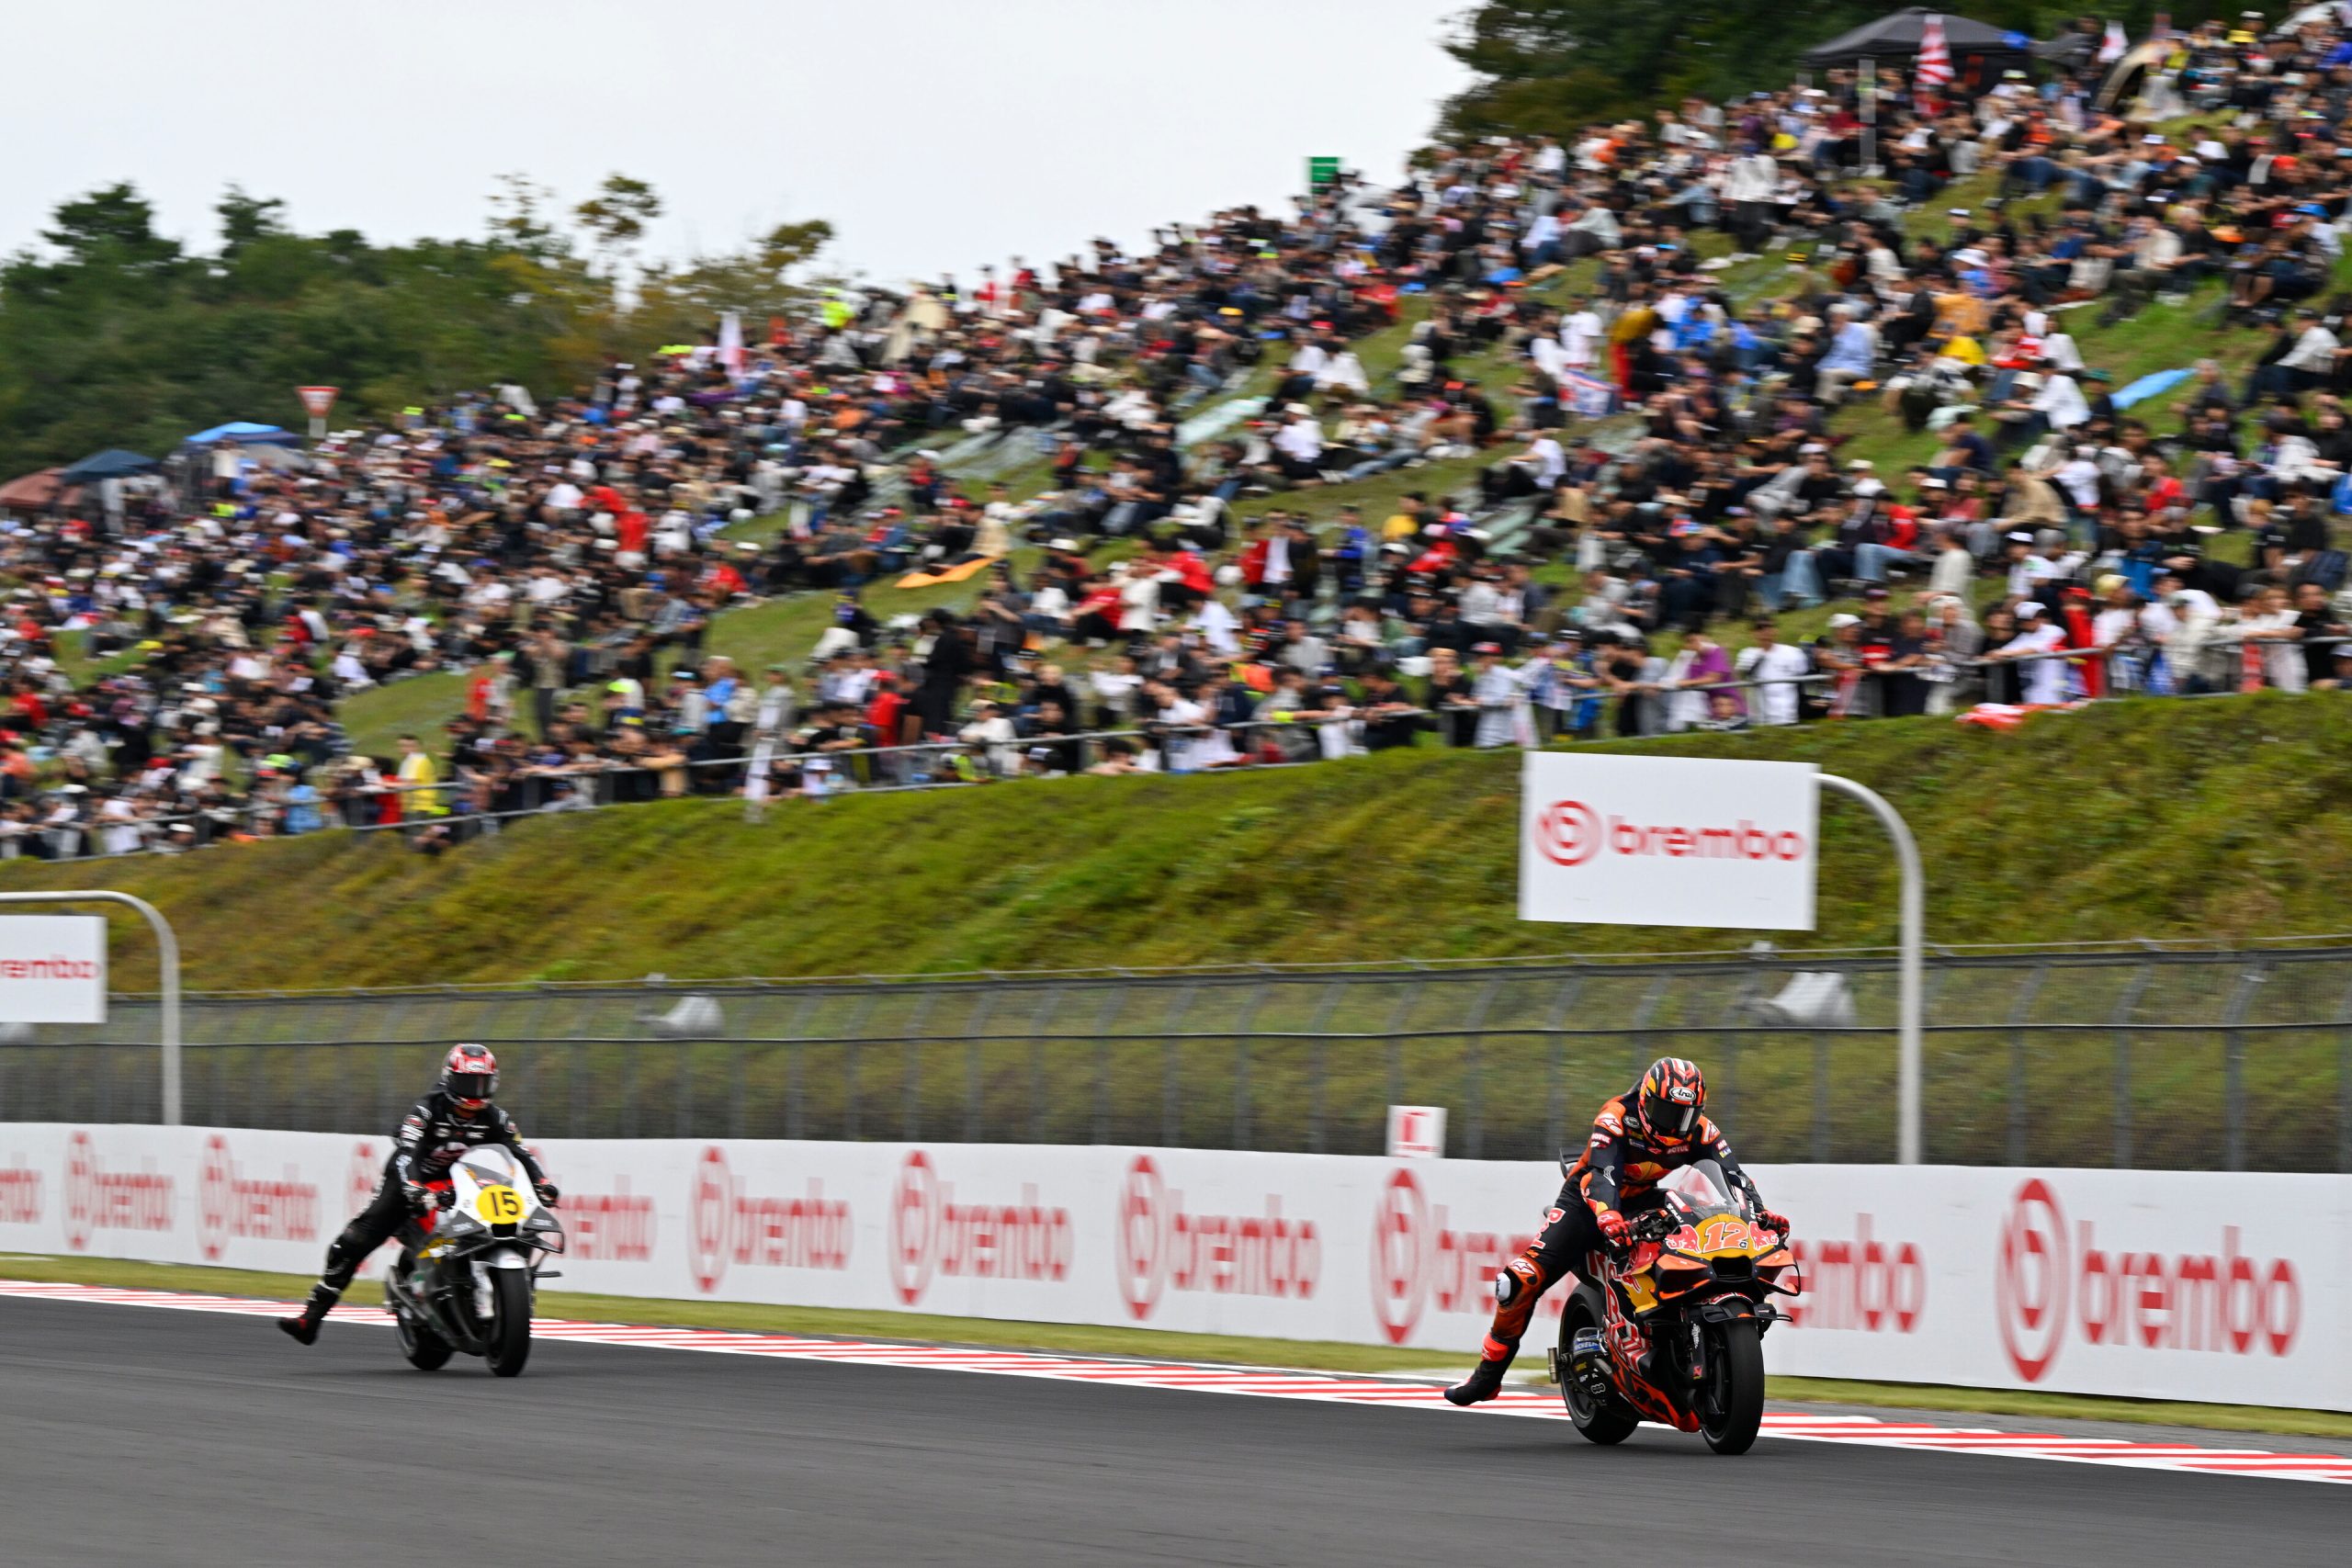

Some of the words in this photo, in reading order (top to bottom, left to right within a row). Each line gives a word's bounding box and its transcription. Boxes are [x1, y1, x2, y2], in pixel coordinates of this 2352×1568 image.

[1608, 814, 1807, 863] brembo
[0, 1151, 44, 1224] mbo
[90, 1155, 177, 1231] brembo
[226, 1160, 322, 1243] brembo
[491, 1190, 520, 1215] 15
[732, 1175, 855, 1270] brembo
[936, 1181, 1075, 1282] brembo
[1164, 1189, 1323, 1301] brembo
[1702, 1222, 1749, 1253] 12
[1780, 1212, 1928, 1334] embo
[2075, 1219, 2303, 1359] brembo
